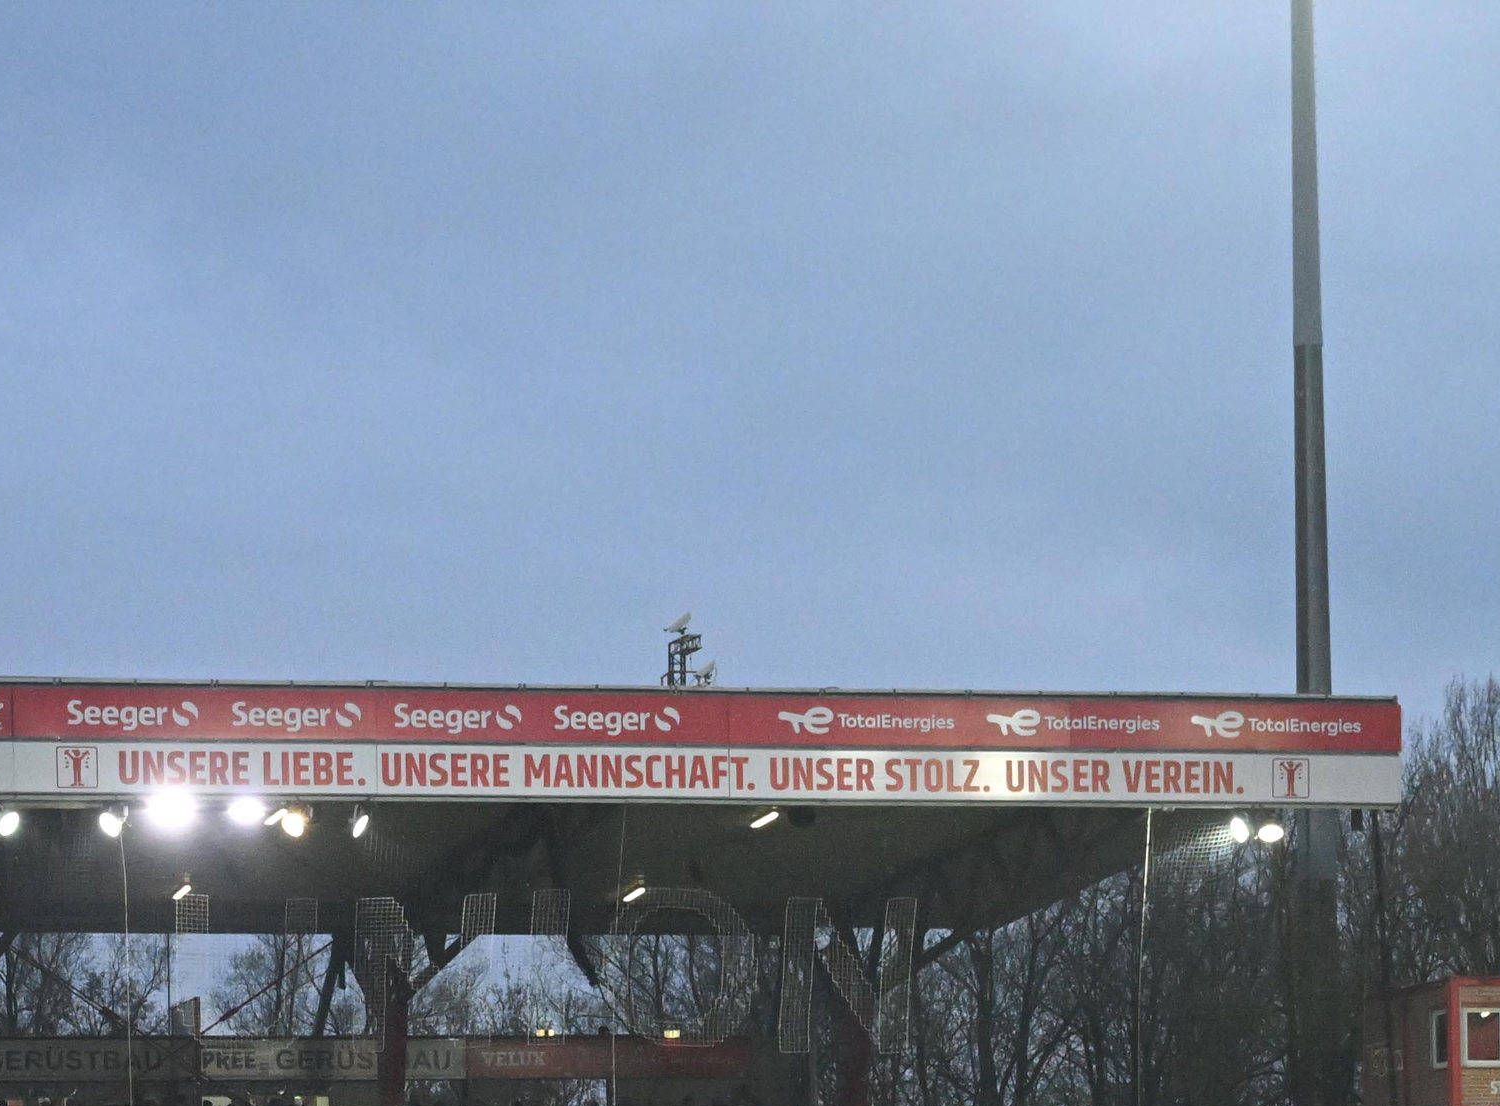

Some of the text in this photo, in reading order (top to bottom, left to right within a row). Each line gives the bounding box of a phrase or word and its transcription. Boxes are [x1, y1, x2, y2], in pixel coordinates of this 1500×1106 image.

[67, 700, 167, 731] Seeger
[232, 702, 330, 732] Seeger
[394, 703, 492, 734] Seeger
[553, 705, 650, 736] Seeger
[837, 713, 955, 733] TotalEnergies
[1045, 715, 1160, 733] TotalEnergies
[1249, 717, 1361, 735] TotalEnergies
[118, 750, 1245, 795] UNSERE LIEBE. UNSERE MANNSCHAFT. UNSER STOLZ. UNSER VEREIN.
[275, 1047, 451, 1073] GERÜSAU
